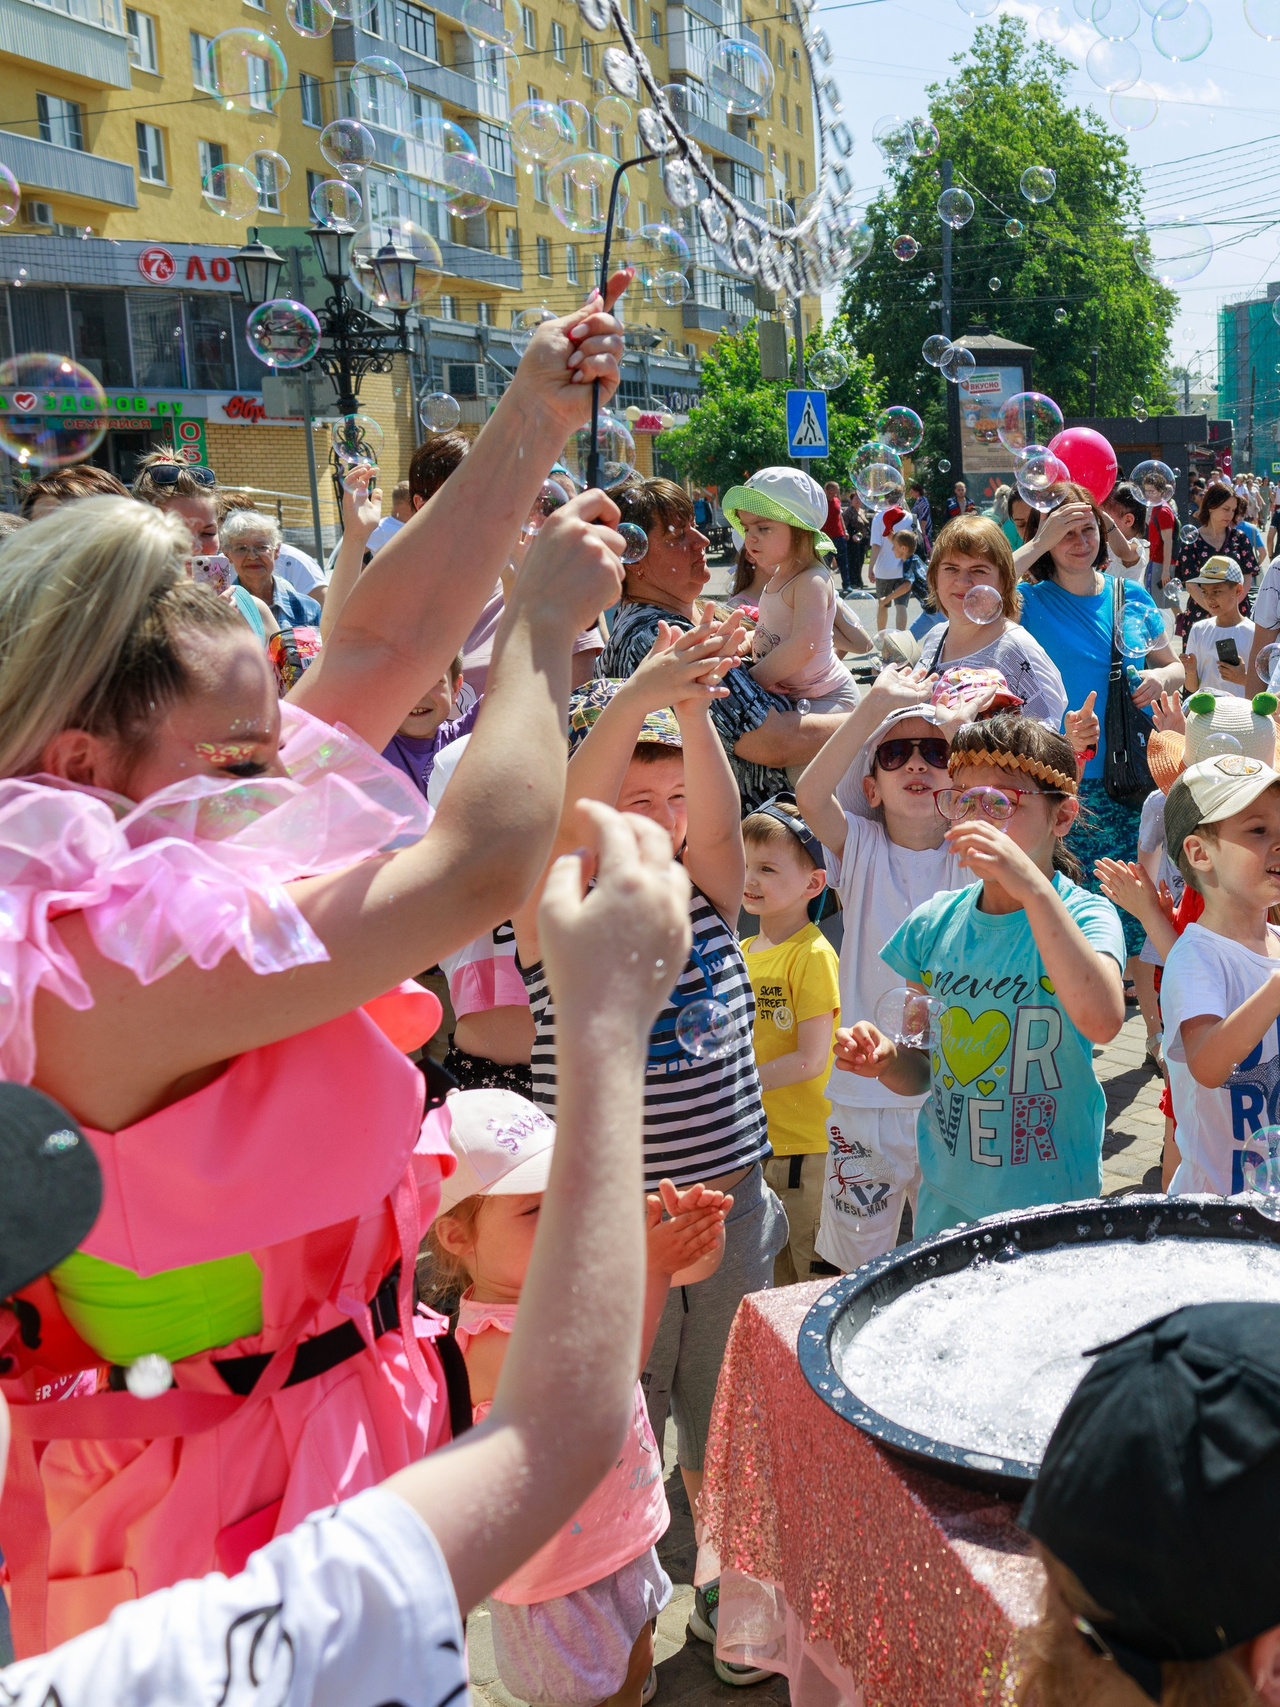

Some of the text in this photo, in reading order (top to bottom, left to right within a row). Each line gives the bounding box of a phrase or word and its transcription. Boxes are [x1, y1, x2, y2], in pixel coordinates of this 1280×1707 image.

[186, 255, 240, 283] ЛО
[970, 382, 999, 390] ВКУСНО
[63, 417, 152, 430] ОБУВАЙСЯ
[760, 985, 783, 997] SKATE
[934, 970, 1038, 1005] never
[757, 997, 788, 1008] STREET
[944, 1022, 1005, 1057] and
